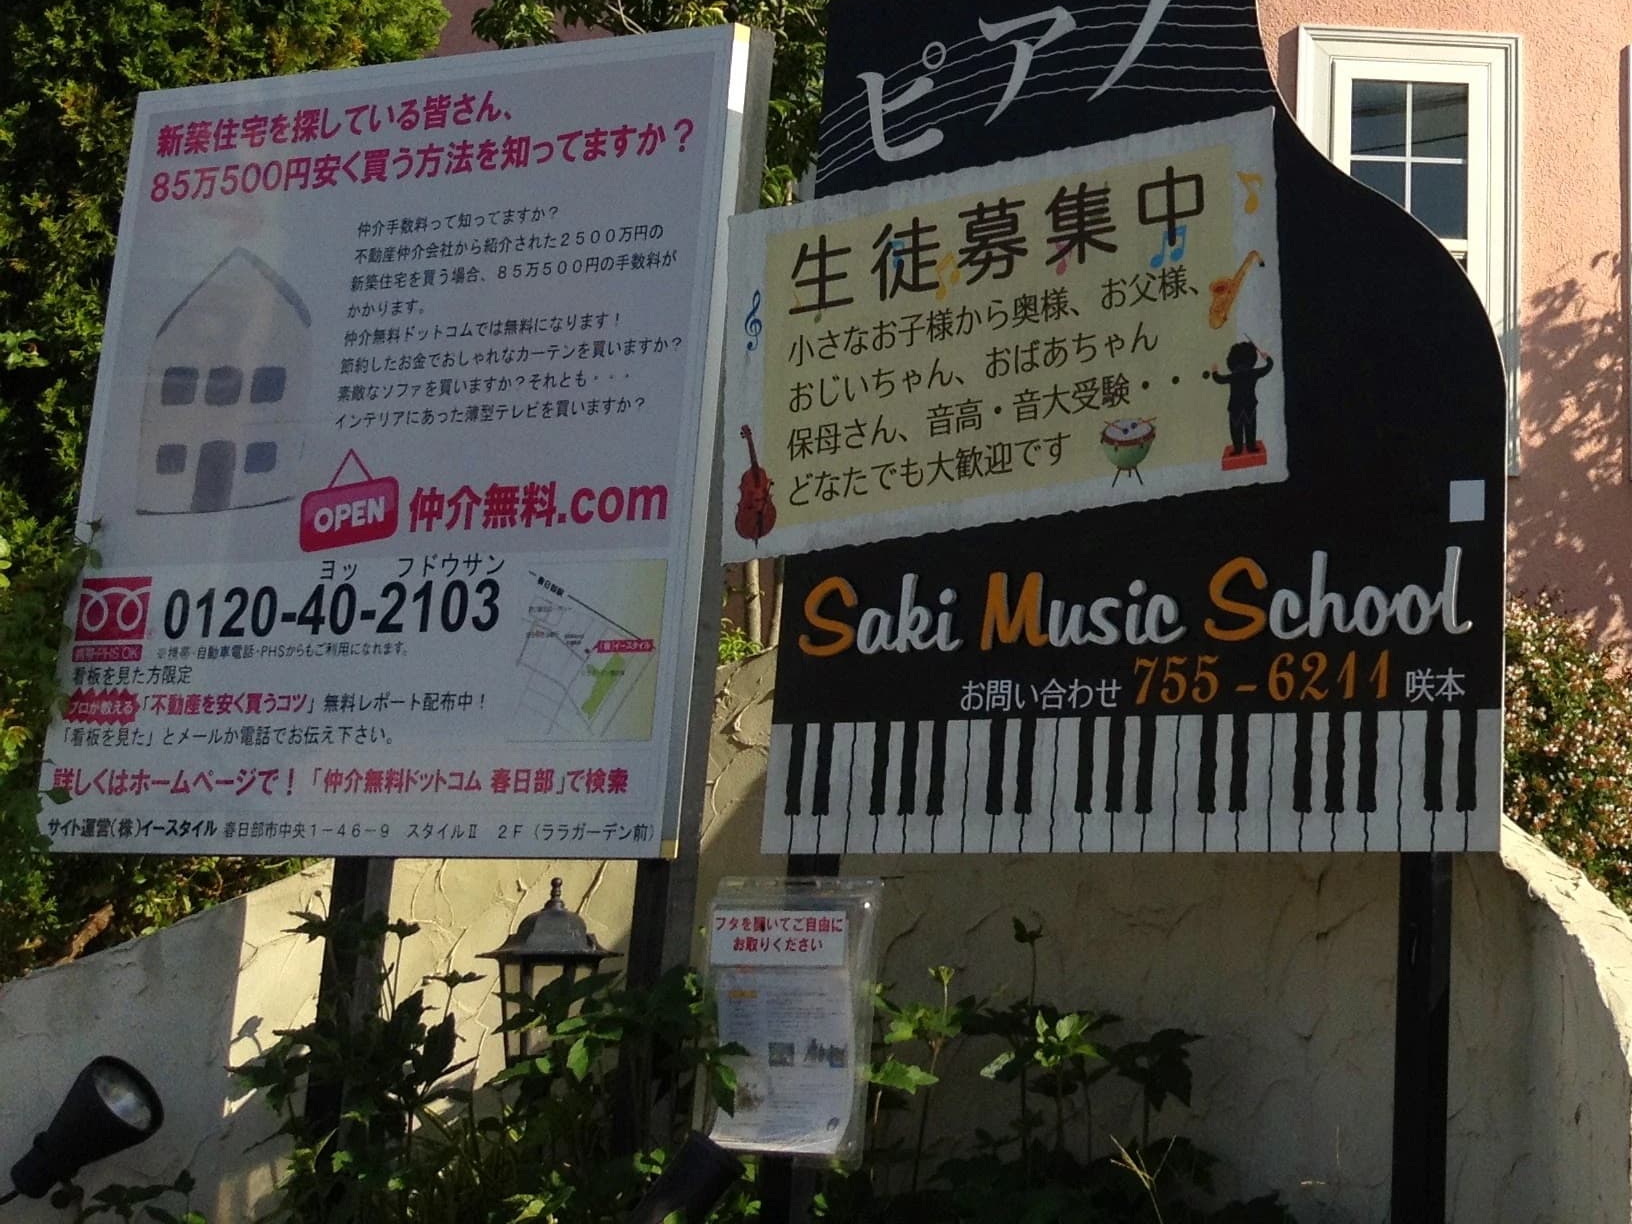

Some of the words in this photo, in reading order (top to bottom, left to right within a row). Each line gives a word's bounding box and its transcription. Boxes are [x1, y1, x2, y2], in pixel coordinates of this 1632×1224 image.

[155, 90, 512, 158] 新築住宅を探している皆さん、
[150, 118, 695, 203] 85万500円安く買う方法を知ってますか？
[357, 206, 559, 238] 仲介手数料って知ってますか？
[787, 166, 1206, 317] 生徒募集中
[344, 312, 620, 347] 仲介無料ドットコムでは無料になります！
[347, 298, 425, 318] かかります。
[788, 321, 1159, 414] おじいちゃん、おばあちゃん
[787, 432, 1073, 507] どなたでも大歓迎です
[314, 495, 386, 533] OPEN
[408, 481, 669, 533] 仲介無料.com
[319, 560, 358, 581] ヨッ
[398, 553, 506, 578] フドウサン
[163, 578, 500, 640] 0120-40-2103
[799, 573, 964, 658] Saki
[980, 572, 1188, 651] Music
[1204, 546, 1473, 642] School
[73, 666, 193, 687] 看板を見た方限定
[959, 678, 1123, 712] お問い合わせ
[1134, 649, 1391, 705] 755-6211
[1404, 667, 1467, 703] 咲本
[732, 936, 824, 952] お取りください
